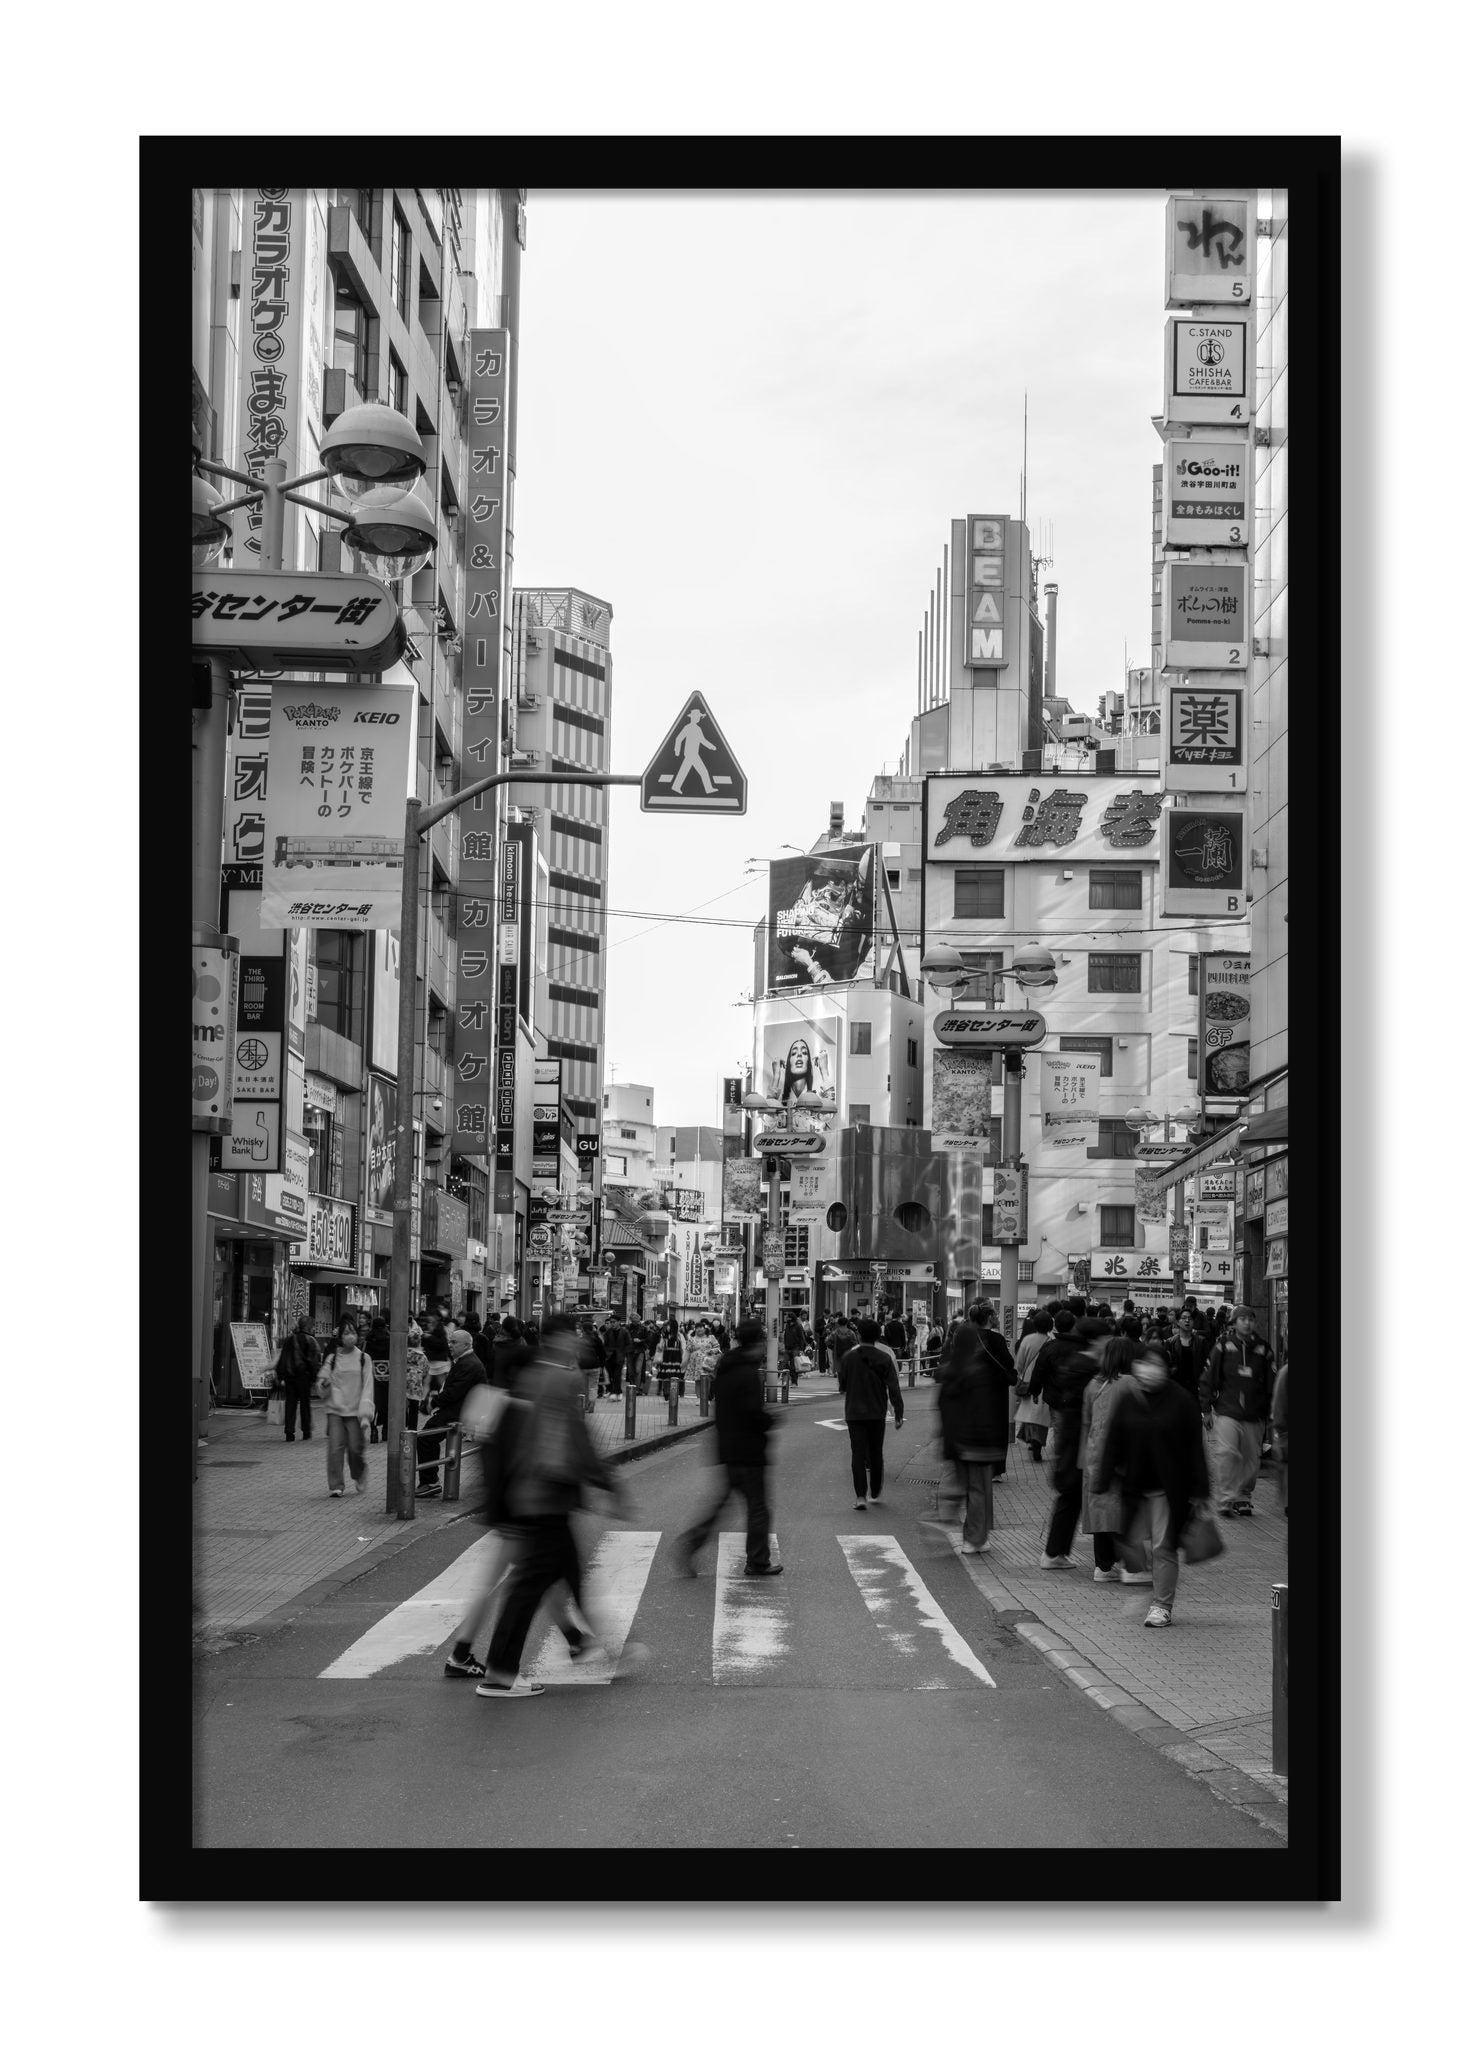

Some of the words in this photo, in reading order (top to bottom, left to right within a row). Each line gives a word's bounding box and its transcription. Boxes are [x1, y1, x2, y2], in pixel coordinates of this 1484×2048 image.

[251, 200, 290, 334] カラオケ
[1232, 282, 1244, 297] 5
[1189, 328, 1232, 338] C.STAND
[1189, 367, 1232, 378] SHISHA
[1189, 378, 1232, 387] CAFE&BAR
[1187, 461, 1240, 477] Goo-it!
[1181, 480, 1237, 490] 渋谷宇田川町店
[1176, 504, 1241, 516] 全身もみほぐし
[1229, 526, 1241, 544] 3
[972, 519, 1004, 659] BEAM
[1177, 594, 1239, 614] ポムの樹
[1229, 648, 1240, 664] 2
[296, 719, 329, 727] KANTO
[354, 711, 400, 725] KEIO
[1180, 695, 1229, 745] 薬
[1174, 748, 1234, 762] マツモトキヨシ
[299, 746, 316, 787] 冒険へ
[317, 746, 335, 818] カントーの
[358, 747, 375, 804] 京王線で
[1228, 772, 1236, 788] 1
[934, 788, 1167, 848] 角海老
[1175, 826, 1233, 873] 一蘭
[506, 846, 515, 880] kimono
[505, 884, 514, 918] hearts
[1227, 895, 1239, 912] B
[288, 902, 373, 916] 渋谷センター街
[1208, 972, 1250, 984] 四川料理
[940, 1019, 1040, 1032] 渋谷センター街
[1206, 1028, 1233, 1047] 6F
[198, 1075, 217, 1089] Day!
[232, 1137, 264, 1148] Whisky
[579, 1141, 598, 1150] GU
[757, 1138, 816, 1146] 渋谷センター街
[1138, 1147, 1192, 1155] 渋谷センター街
[210, 1157, 219, 1167] 1F
